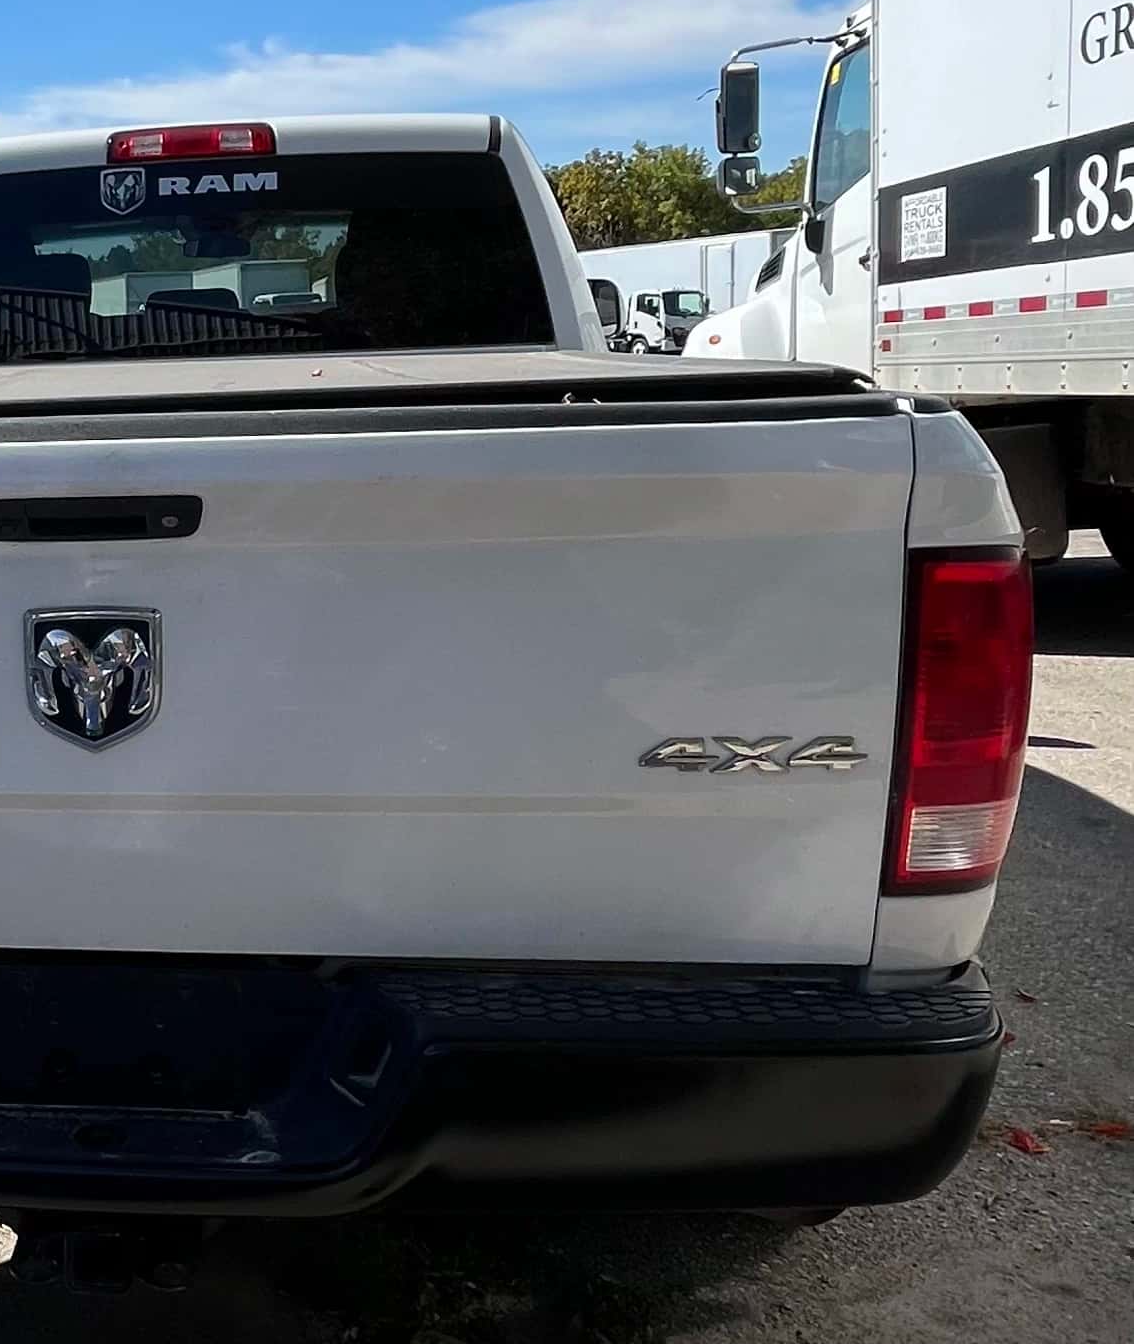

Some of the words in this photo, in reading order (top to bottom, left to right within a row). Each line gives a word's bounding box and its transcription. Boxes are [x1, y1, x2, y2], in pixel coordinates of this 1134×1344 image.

[158, 171, 278, 196] RAM
[905, 203, 943, 221] TRUCK
[904, 216, 943, 233] RENTALS
